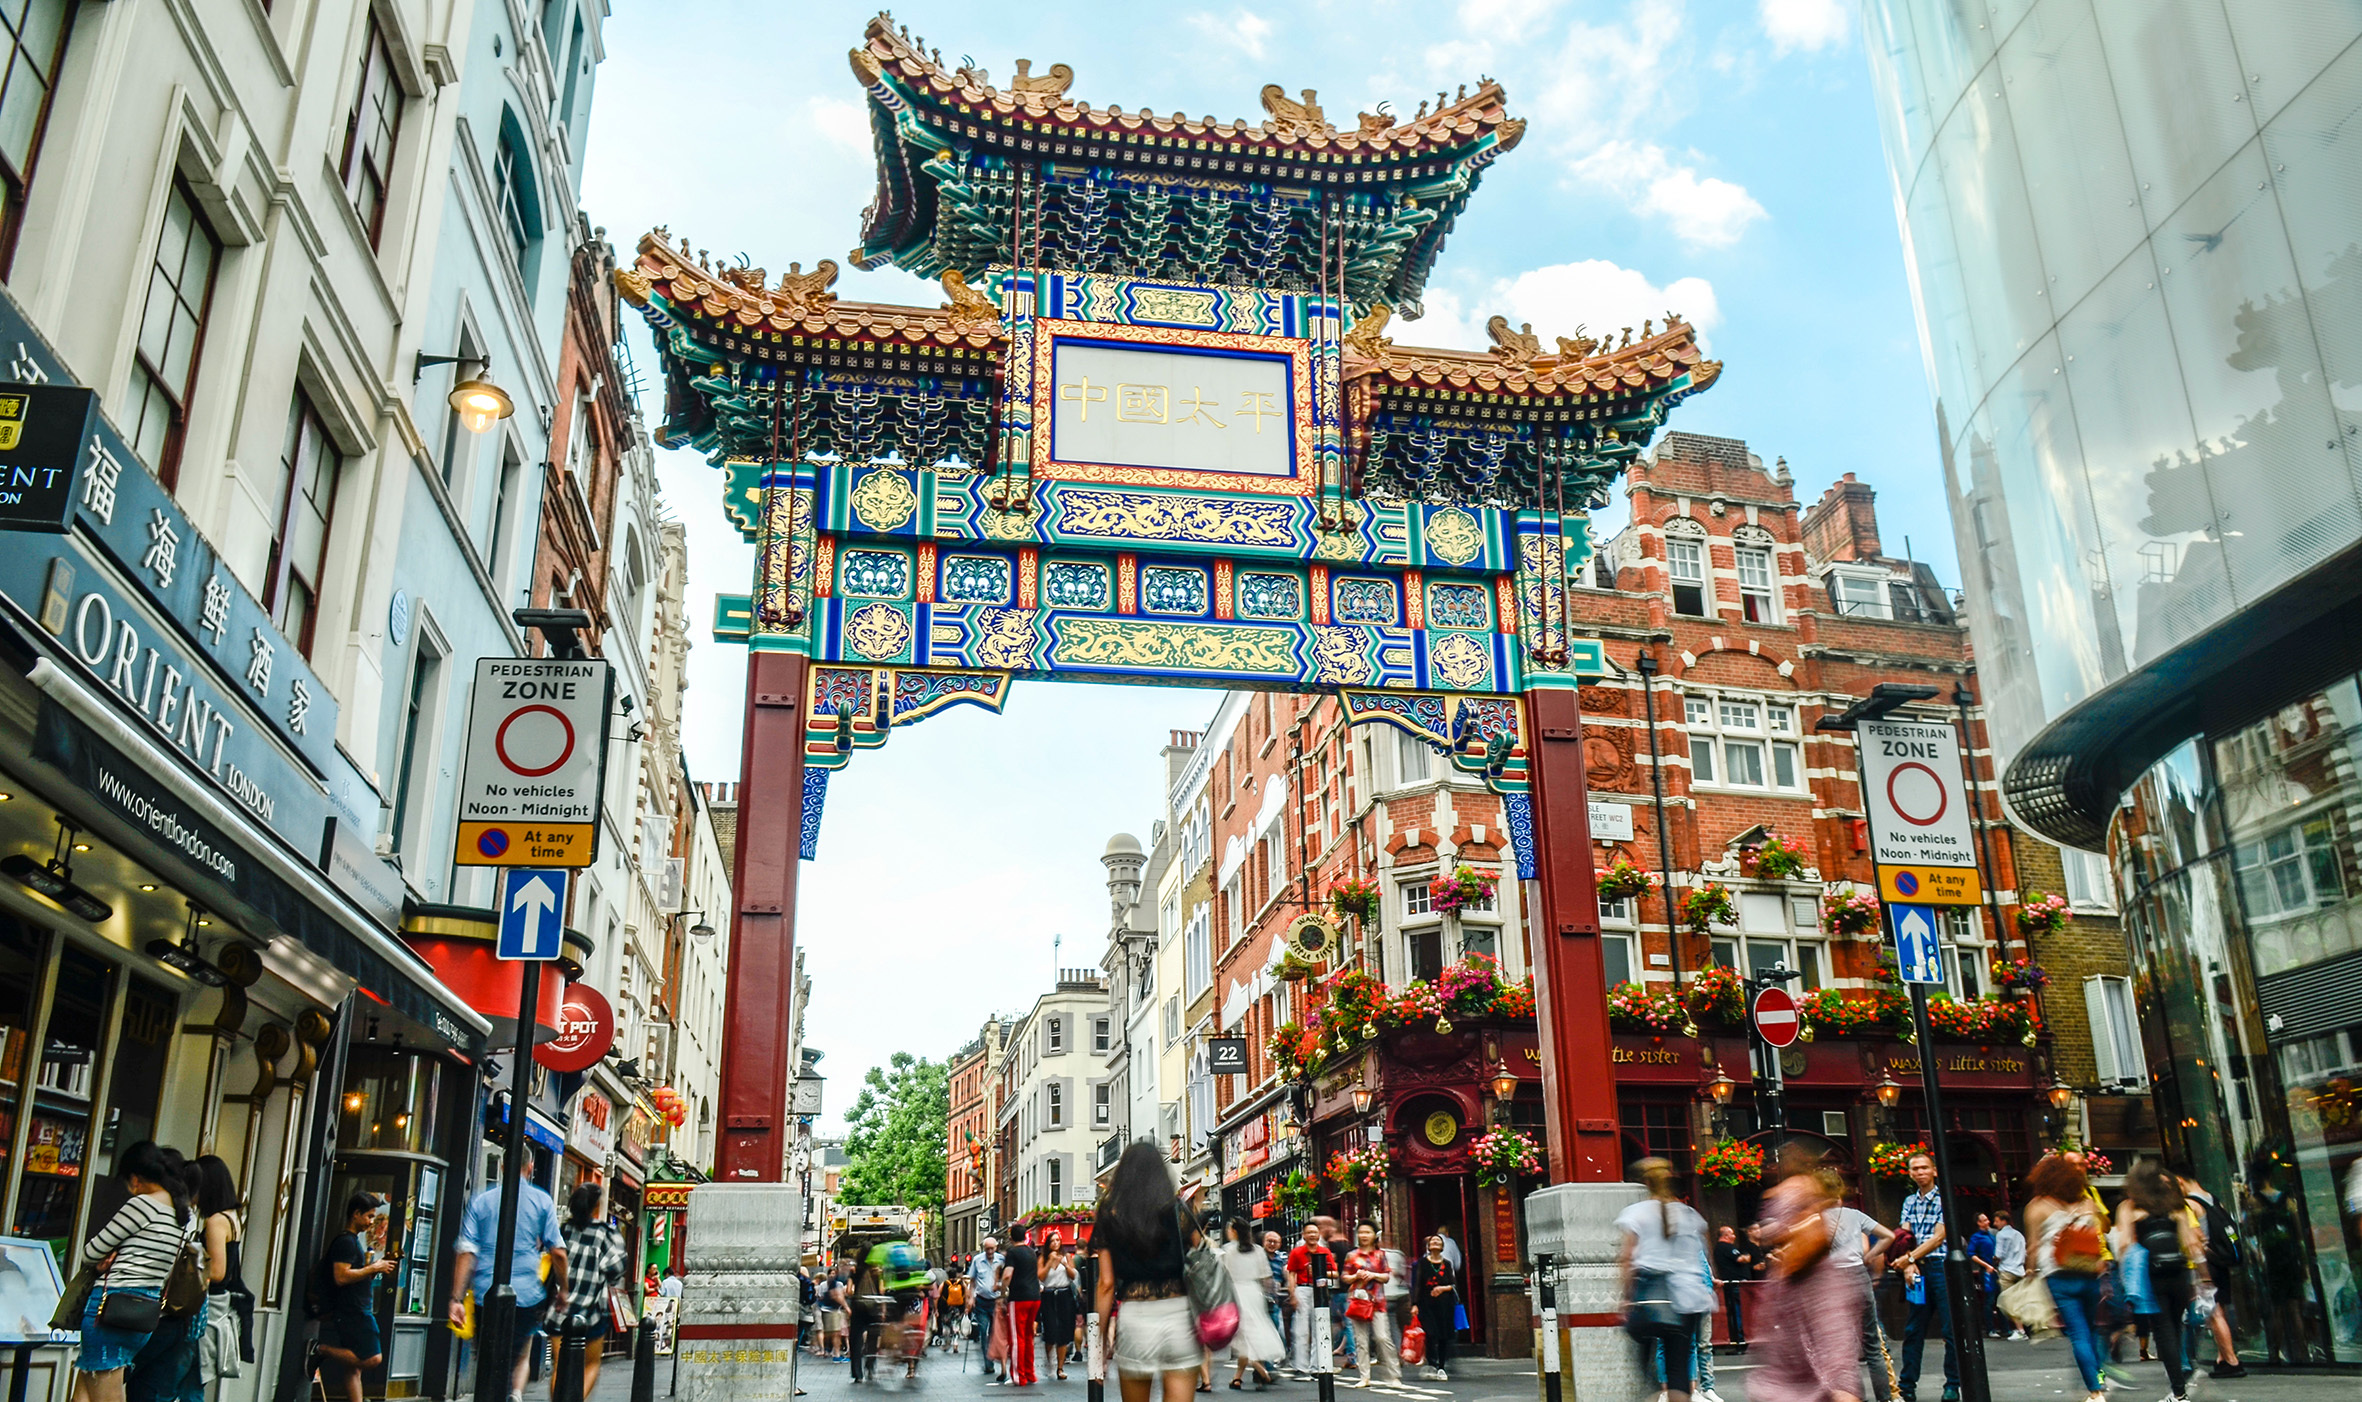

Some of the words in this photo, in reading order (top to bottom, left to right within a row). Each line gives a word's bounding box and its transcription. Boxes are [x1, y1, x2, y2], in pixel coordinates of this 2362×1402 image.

[1059, 375, 1283, 434] 中國太平
[490, 664, 593, 678] PEDESTRIAN
[502, 681, 576, 700] ZONE
[75, 592, 233, 777] ORIENT
[227, 763, 275, 821] LONDON
[1869, 725, 1947, 739] PEDESTRIAN
[1882, 740, 1939, 758] ZONE
[486, 784, 507, 797] No
[513, 785, 575, 798] vehicles
[468, 803, 508, 815] Noon
[521, 803, 589, 818] Midnight
[98, 766, 236, 882] www.orientlondon.com
[1608, 814, 1624, 823] WC2
[523, 830, 542, 843] At
[547, 833, 574, 846] any
[1890, 832, 1905, 843] No
[1910, 833, 1957, 845] vehicles
[531, 845, 564, 858] time
[1881, 848, 1911, 859] Noon
[1921, 849, 1971, 863] Midnight
[1929, 873, 1943, 884] At
[1946, 875, 1966, 886] any
[1936, 886, 1962, 898] time
[569, 1021, 599, 1034] POT
[1218, 1046, 1238, 1060] 22
